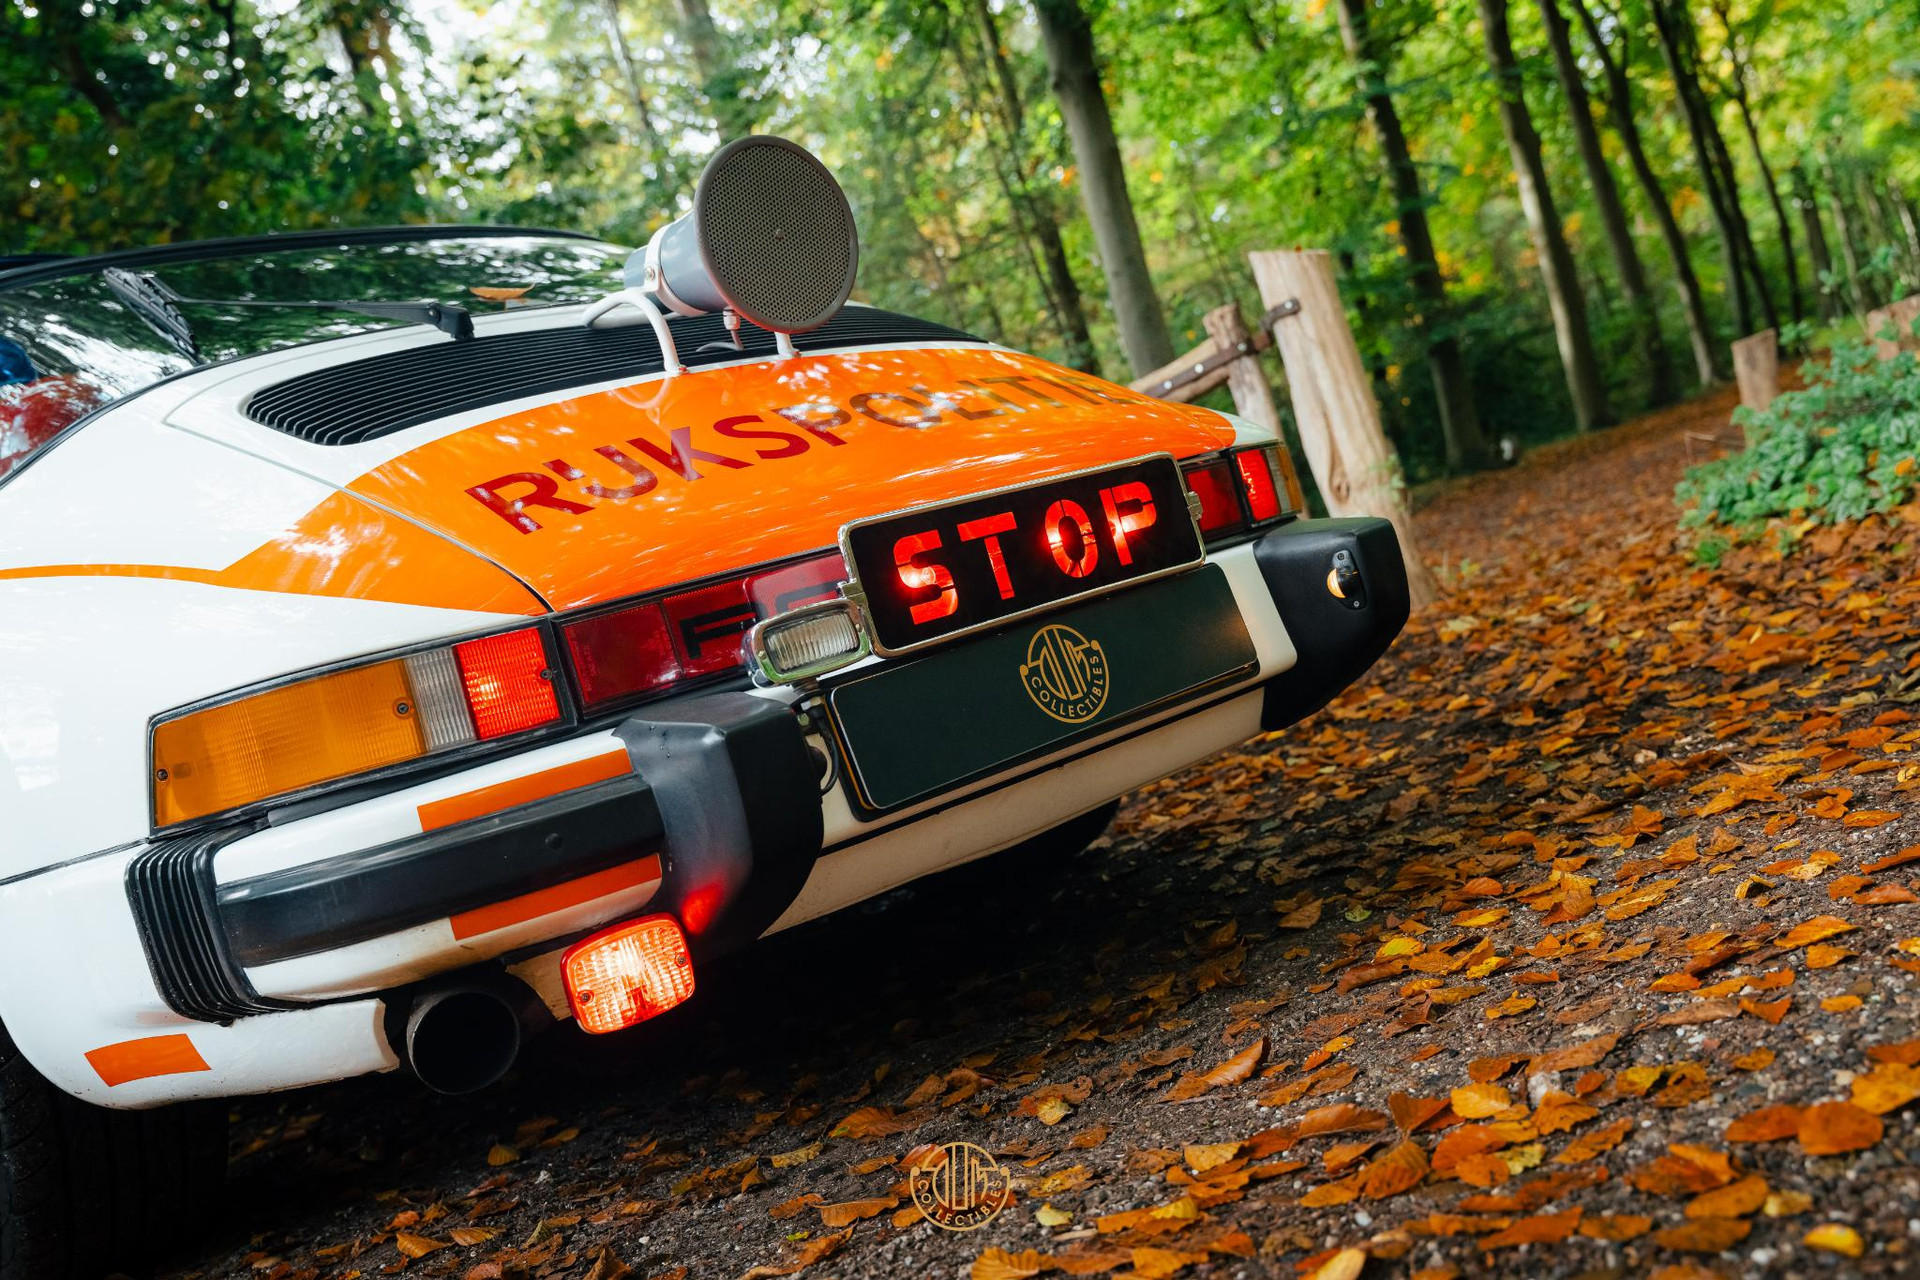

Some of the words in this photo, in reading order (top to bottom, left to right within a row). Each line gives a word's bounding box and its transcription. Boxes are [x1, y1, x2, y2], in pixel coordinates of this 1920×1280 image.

[464, 376, 1148, 535] RIJKSPOLITIE
[893, 481, 1157, 625] STOP
[1031, 655, 1103, 717] COLLECTIBLES
